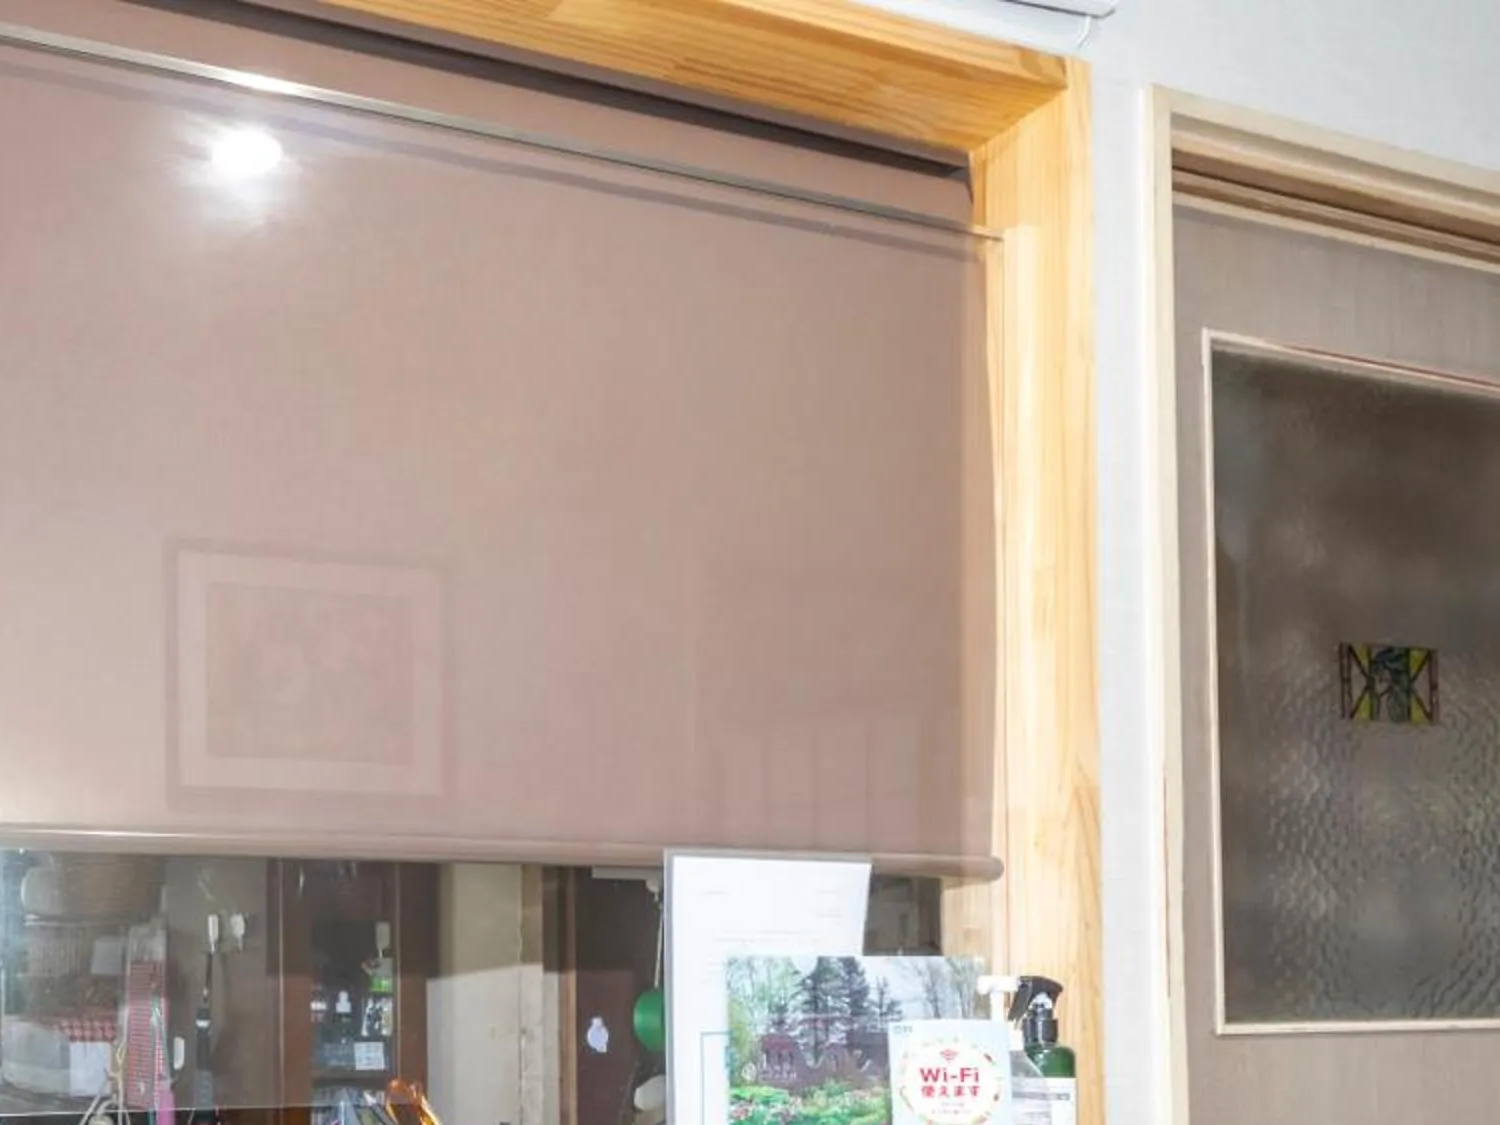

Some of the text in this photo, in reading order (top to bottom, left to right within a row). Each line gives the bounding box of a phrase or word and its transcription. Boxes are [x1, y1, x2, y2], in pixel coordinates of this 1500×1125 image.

[919, 1067, 980, 1083] Wi-Fi
[921, 1086, 980, 1098] 使えます
